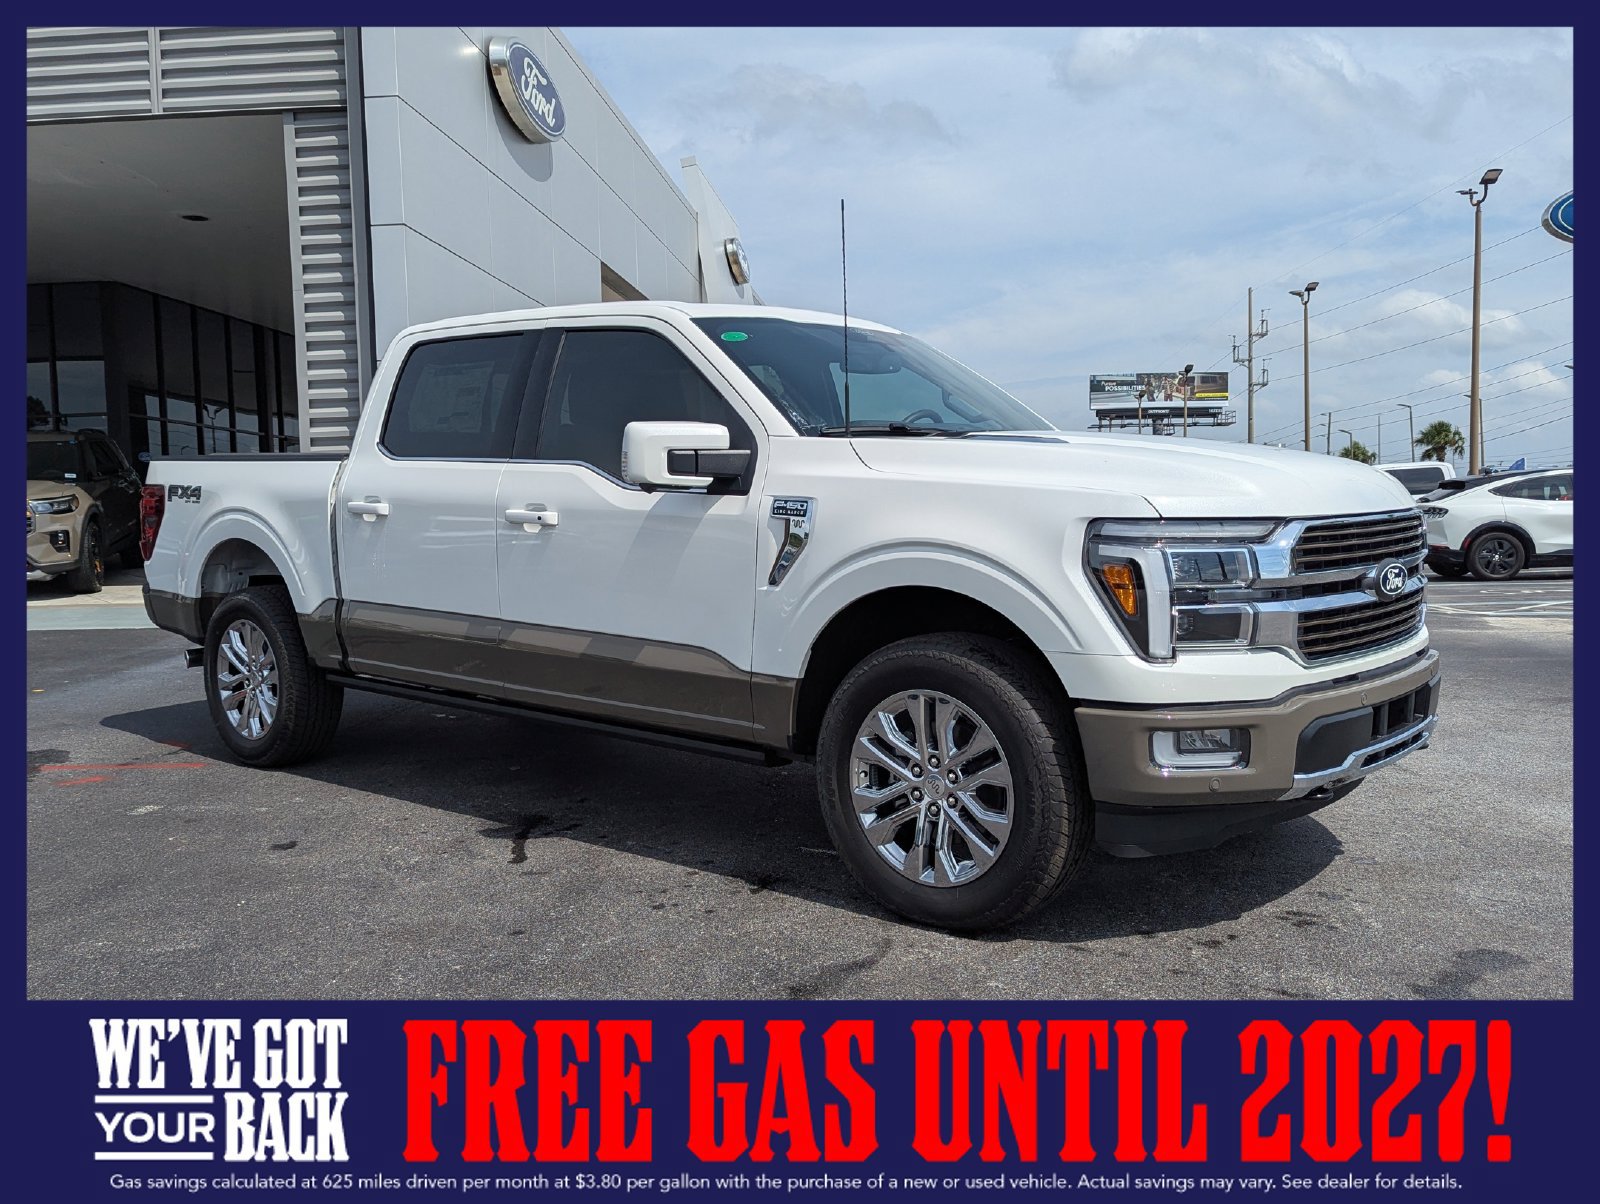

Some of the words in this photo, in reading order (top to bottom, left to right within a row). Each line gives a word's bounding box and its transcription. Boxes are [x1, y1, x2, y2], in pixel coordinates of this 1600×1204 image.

[521, 57, 556, 127] Ford
[168, 485, 202, 502] FX4
[773, 500, 808, 510] F-150
[1386, 568, 1404, 590] Ford
